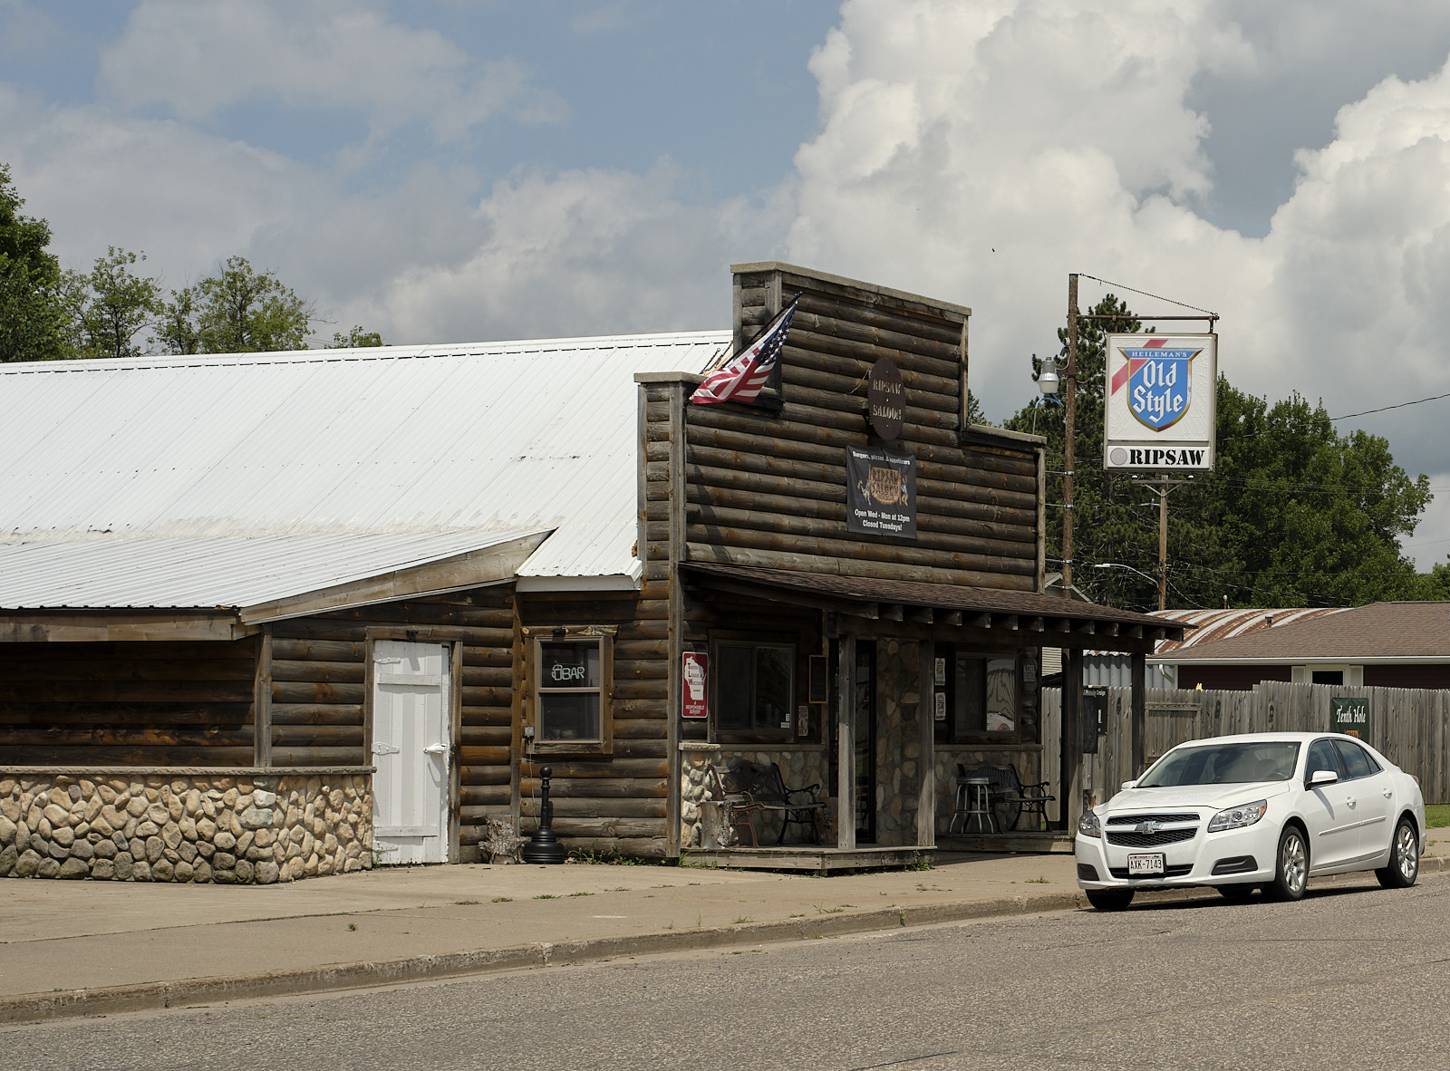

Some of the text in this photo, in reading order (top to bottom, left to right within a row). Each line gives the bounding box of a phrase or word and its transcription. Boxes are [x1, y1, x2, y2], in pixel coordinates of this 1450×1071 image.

[1143, 360, 1177, 388] Old
[873, 379, 902, 395] RIPSAW
[1133, 385, 1184, 423] Style
[1129, 448, 1205, 465] RIPSAW
[854, 508, 867, 518] Open
[862, 520, 879, 529] Closed
[563, 666, 585, 680] BAR
[1336, 705, 1366, 722] Tenth Hole
